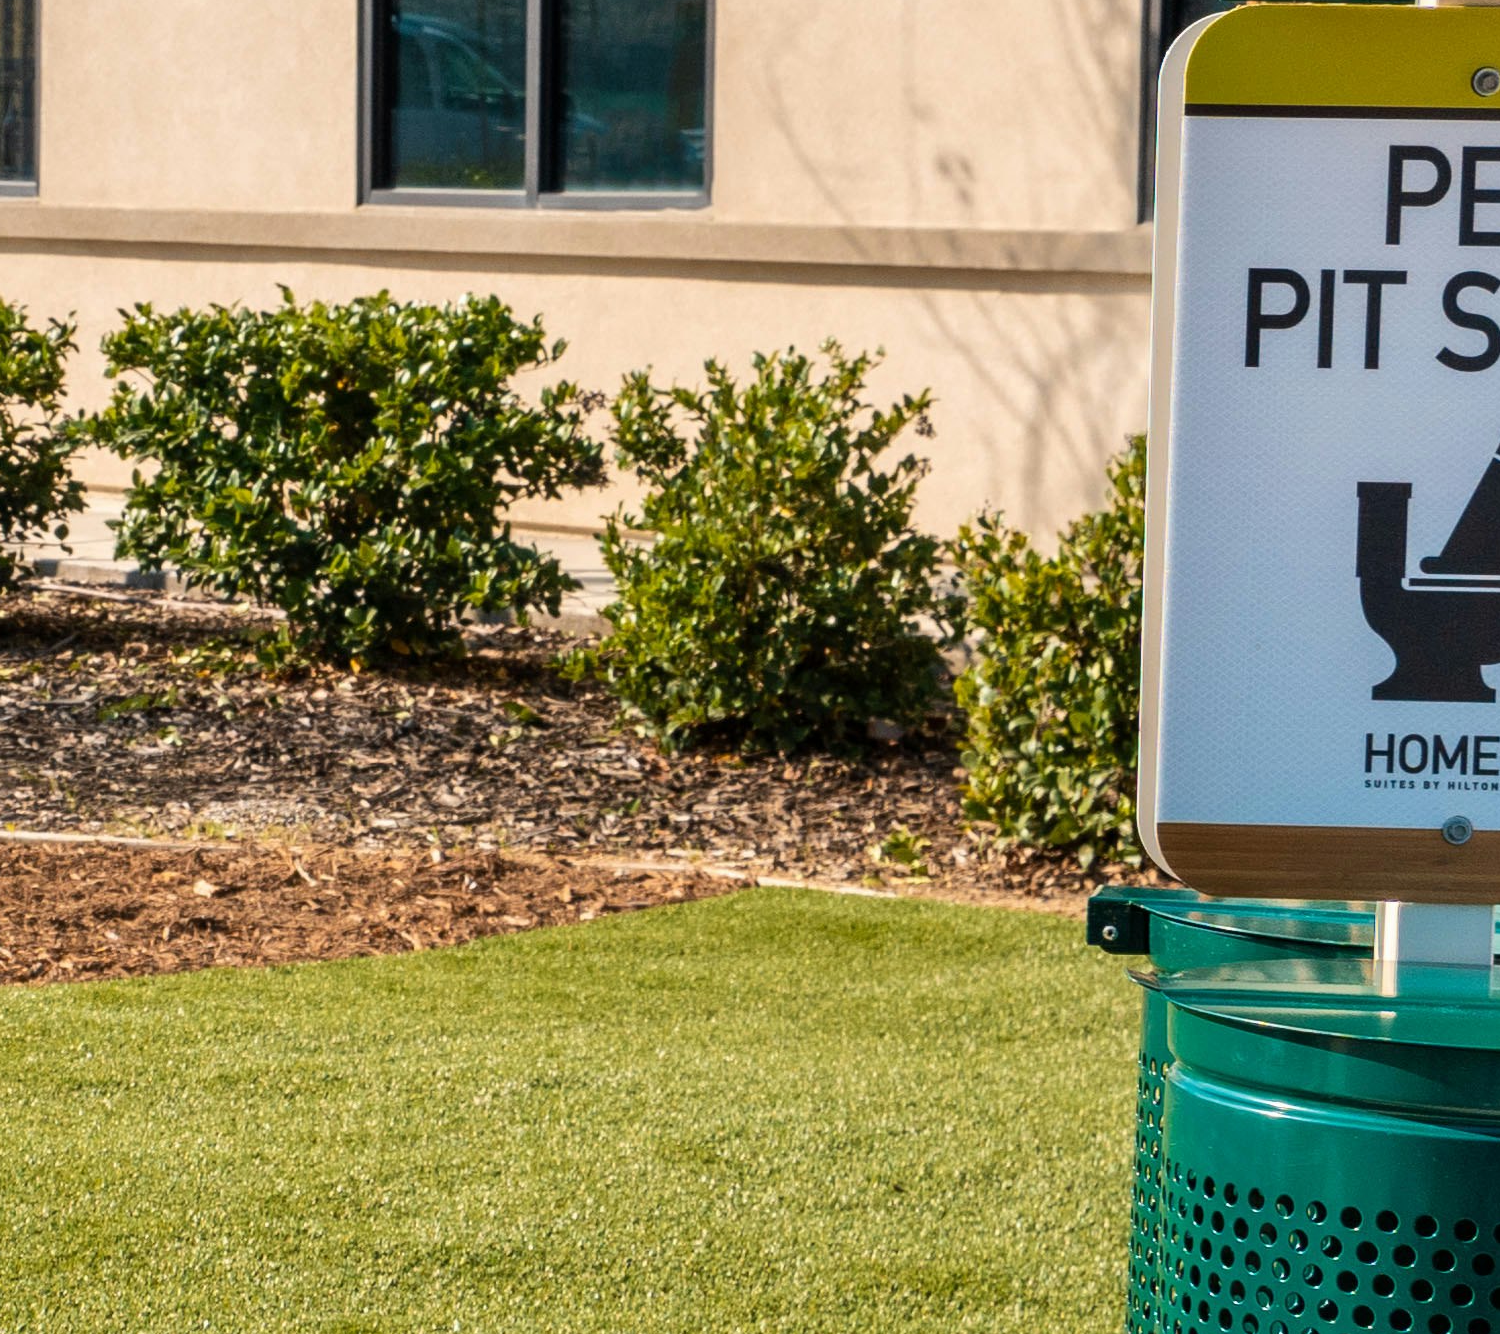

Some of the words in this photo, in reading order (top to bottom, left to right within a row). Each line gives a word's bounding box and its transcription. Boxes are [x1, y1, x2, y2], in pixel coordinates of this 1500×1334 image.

[1244, 267, 1408, 370] PIT
[1364, 779, 1416, 790] SUITES
[1423, 780, 1440, 790] BY
[1447, 781, 1499, 792] HILTON
